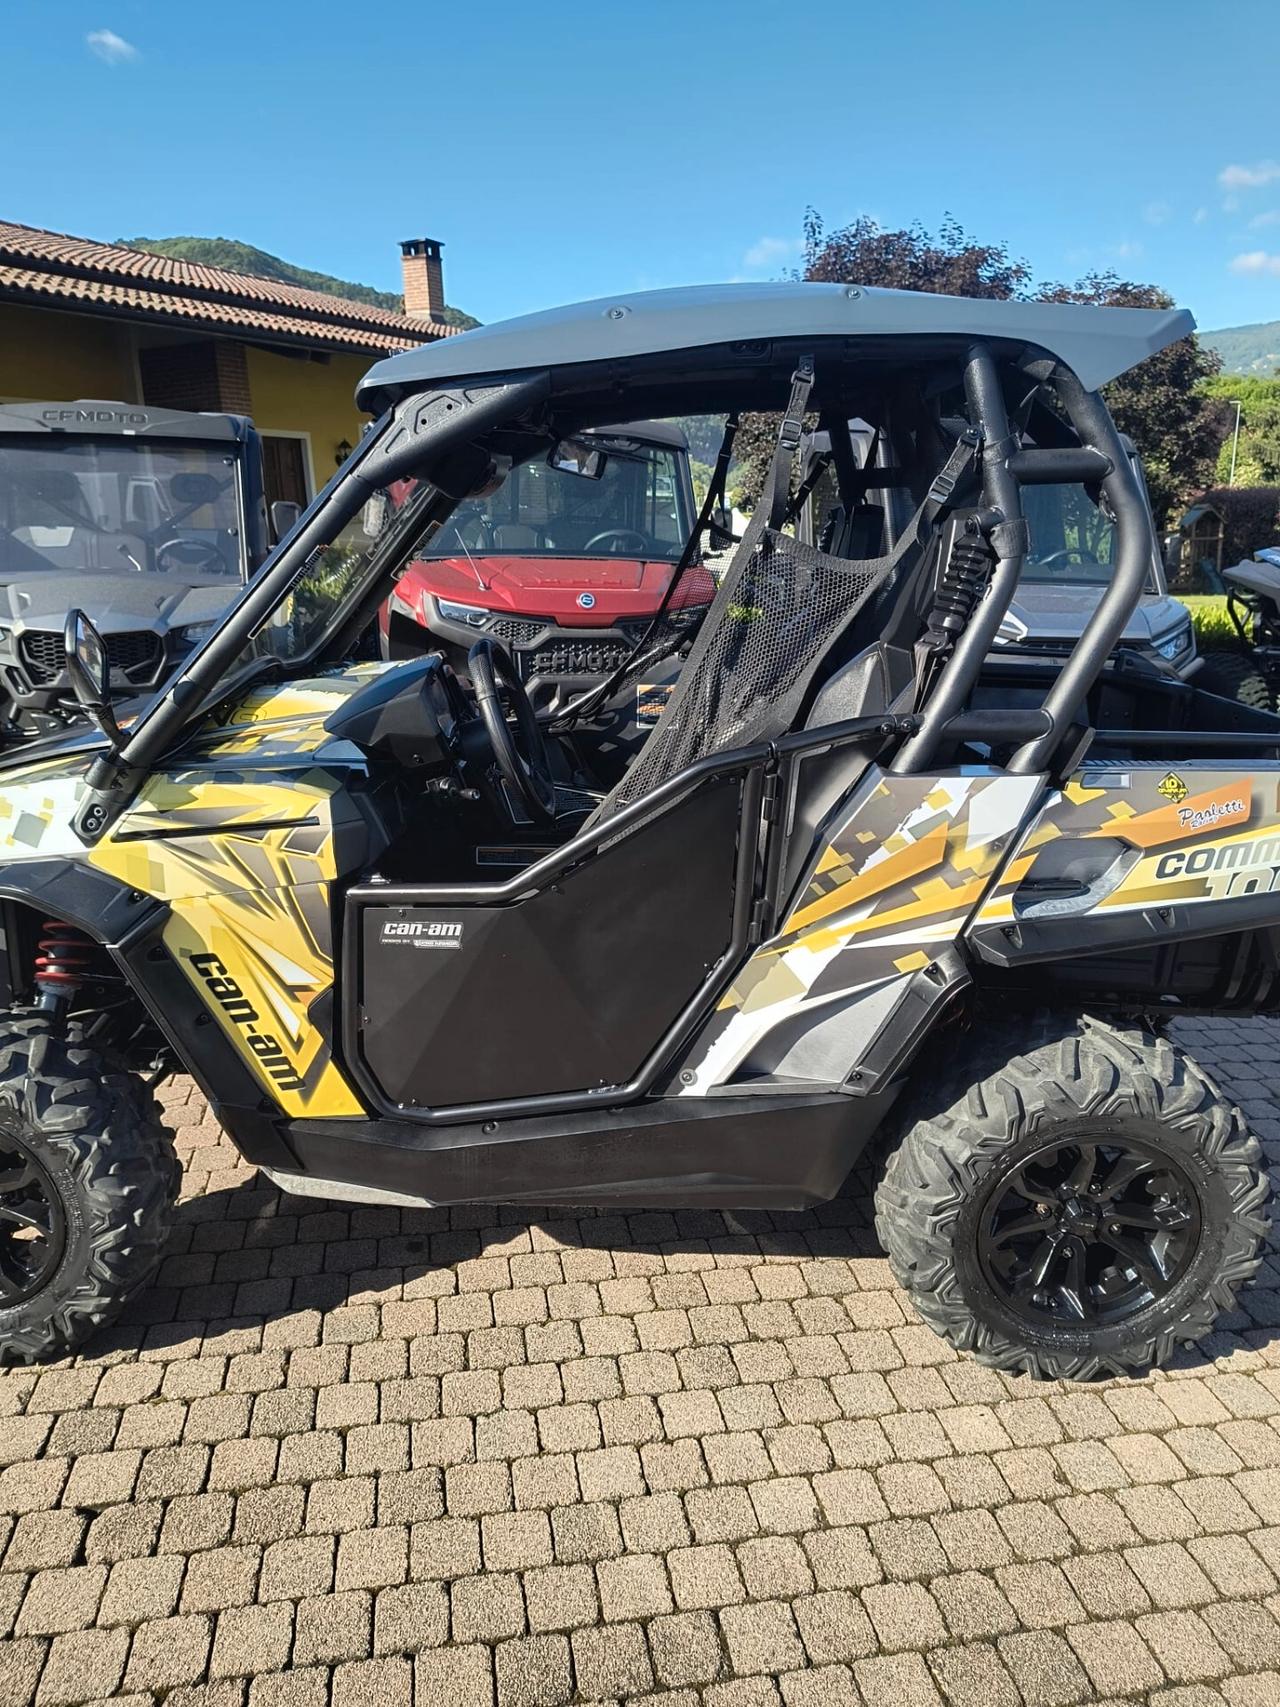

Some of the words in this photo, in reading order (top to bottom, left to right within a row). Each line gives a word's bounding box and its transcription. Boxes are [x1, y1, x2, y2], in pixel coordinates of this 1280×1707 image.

[42, 410, 149, 424] CFMOTO
[1177, 799, 1244, 826] Paoletti
[1206, 868, 1280, 899] 10
[383, 923, 462, 936] can-am
[189, 952, 307, 1091] can-am
